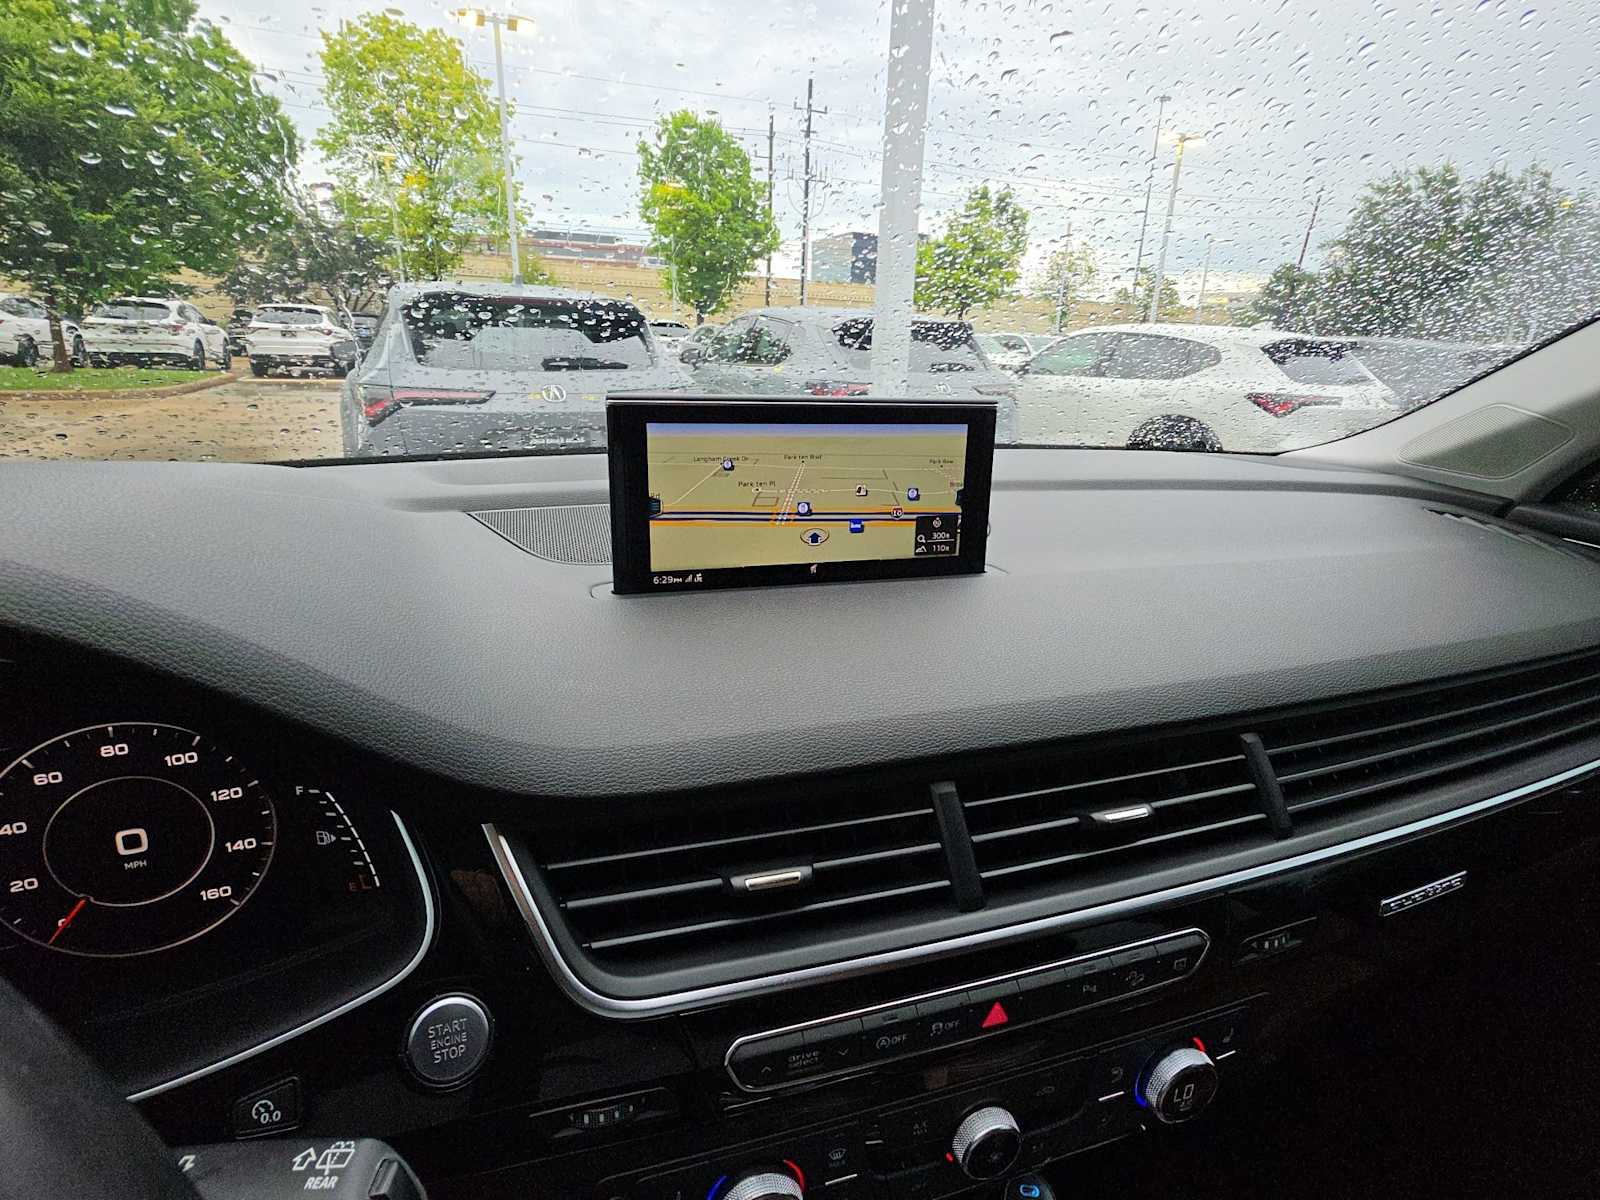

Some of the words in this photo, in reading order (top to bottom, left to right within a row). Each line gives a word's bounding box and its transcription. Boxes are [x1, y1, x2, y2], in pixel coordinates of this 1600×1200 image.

[738, 480, 754, 488] Park
[653, 575, 673, 585] 6:29
[100, 744, 129, 757] 80
[164, 753, 198, 766] 100
[33, 772, 63, 786] 60
[210, 787, 243, 801] 120
[0, 822, 27, 835] 40
[115, 828, 148, 855] 0
[225, 838, 257, 852] 140
[124, 860, 147, 870] MPH
[9, 878, 38, 893] 20
[200, 886, 232, 901] 160
[428, 1018, 468, 1039] START
[431, 1032, 467, 1050] ENGINE
[433, 1044, 466, 1064] STOP
[304, 1176, 338, 1190] REAR
